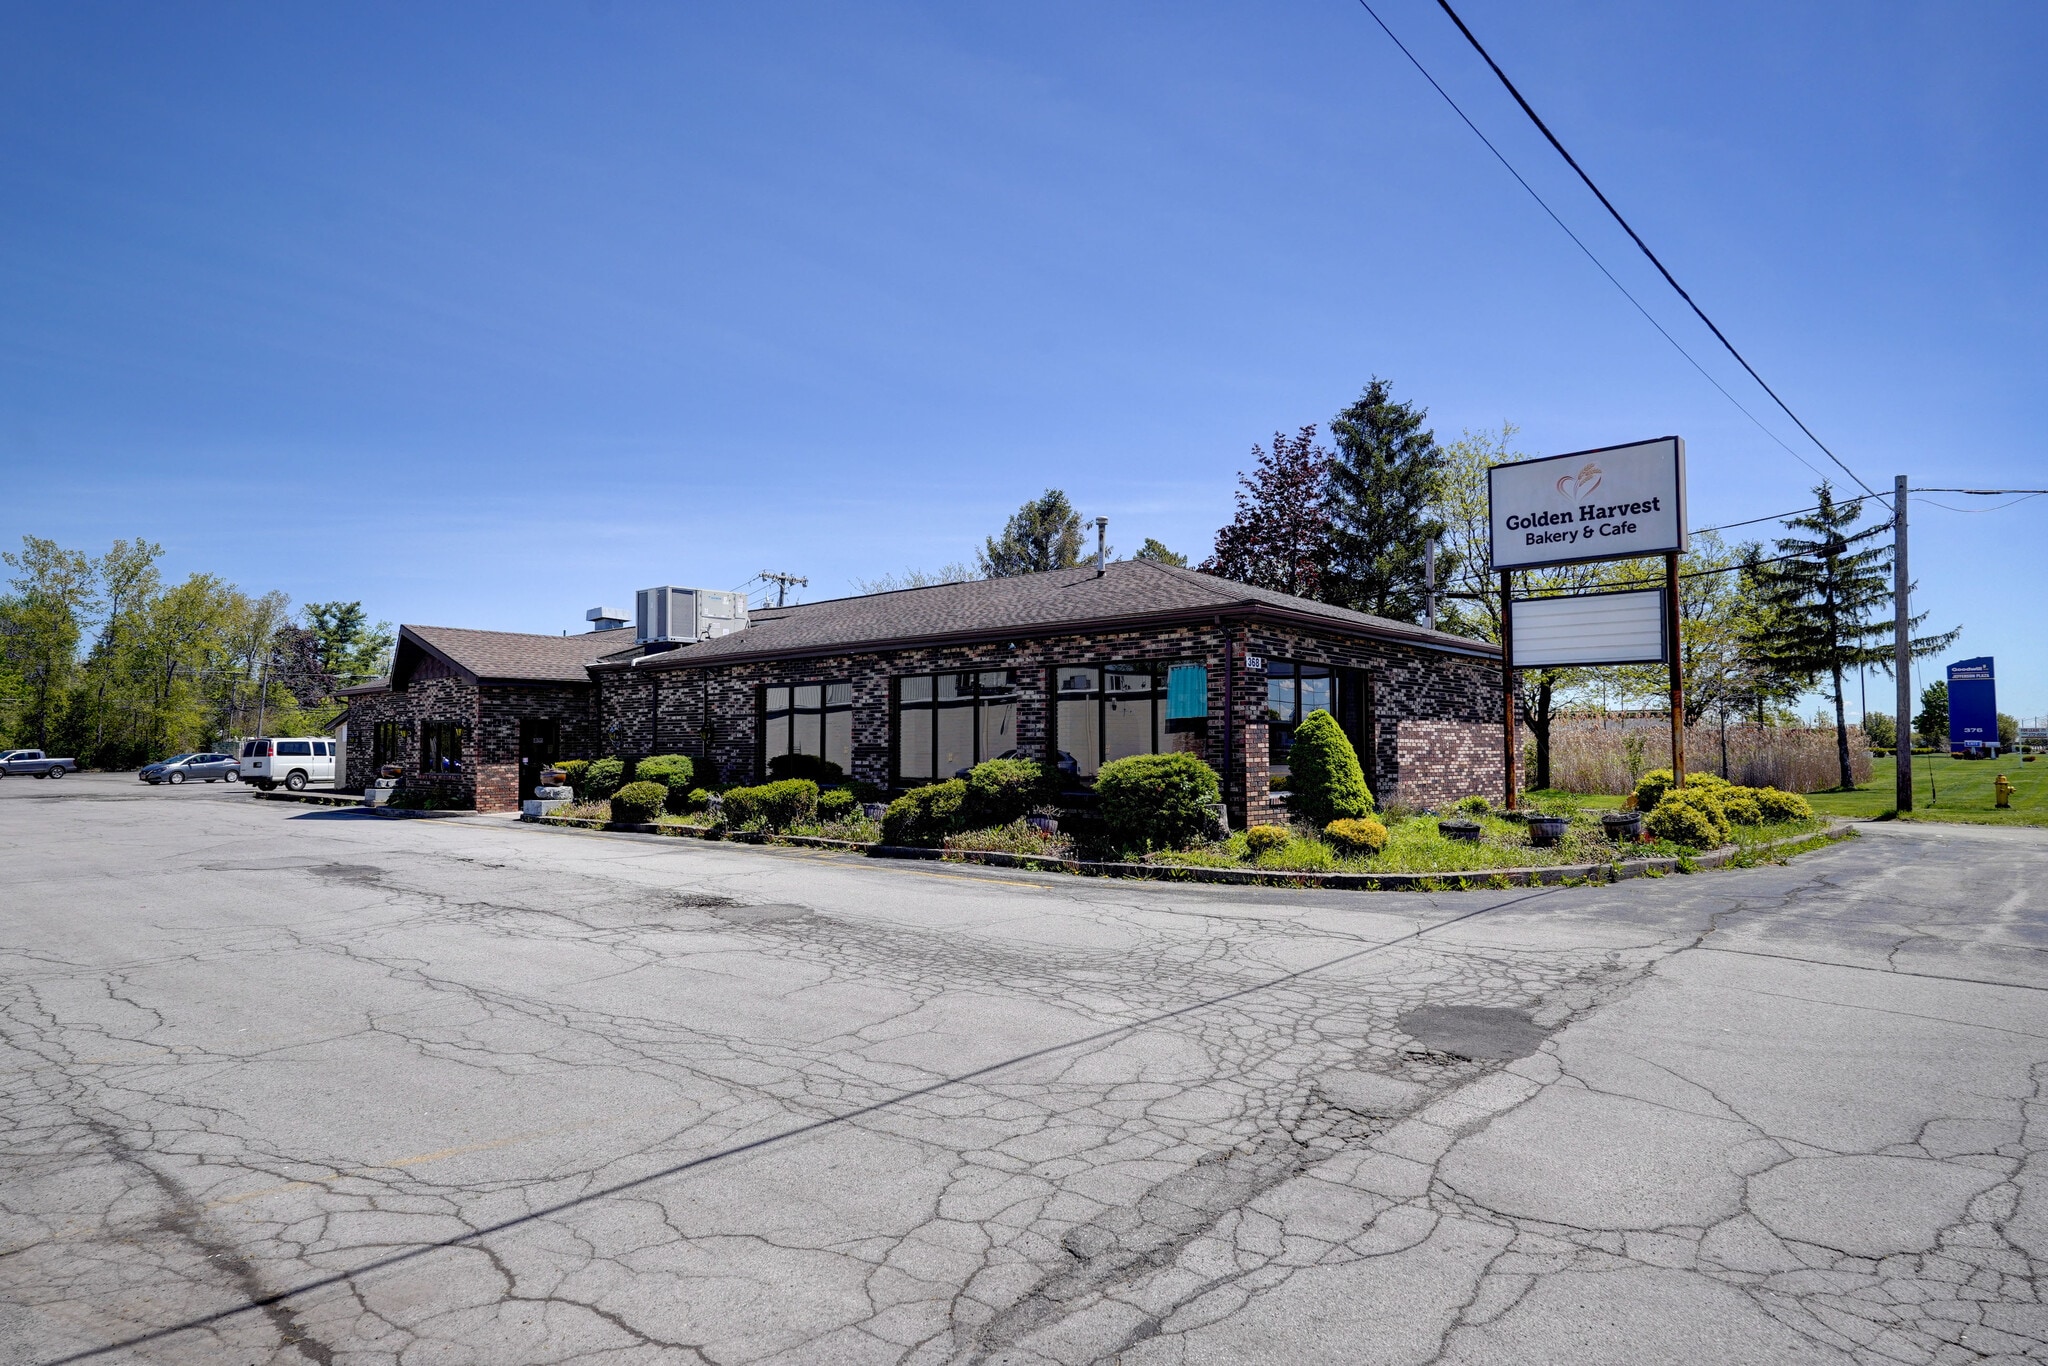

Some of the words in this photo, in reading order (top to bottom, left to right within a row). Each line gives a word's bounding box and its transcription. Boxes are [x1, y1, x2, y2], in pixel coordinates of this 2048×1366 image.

[1506, 511, 1573, 530] Golden
[1579, 497, 1660, 521] Harvest
[1526, 530, 1578, 546] Bakery
[1583, 525, 1594, 539] &
[1600, 521, 1637, 537] Cafe
[1248, 658, 1259, 667] 368
